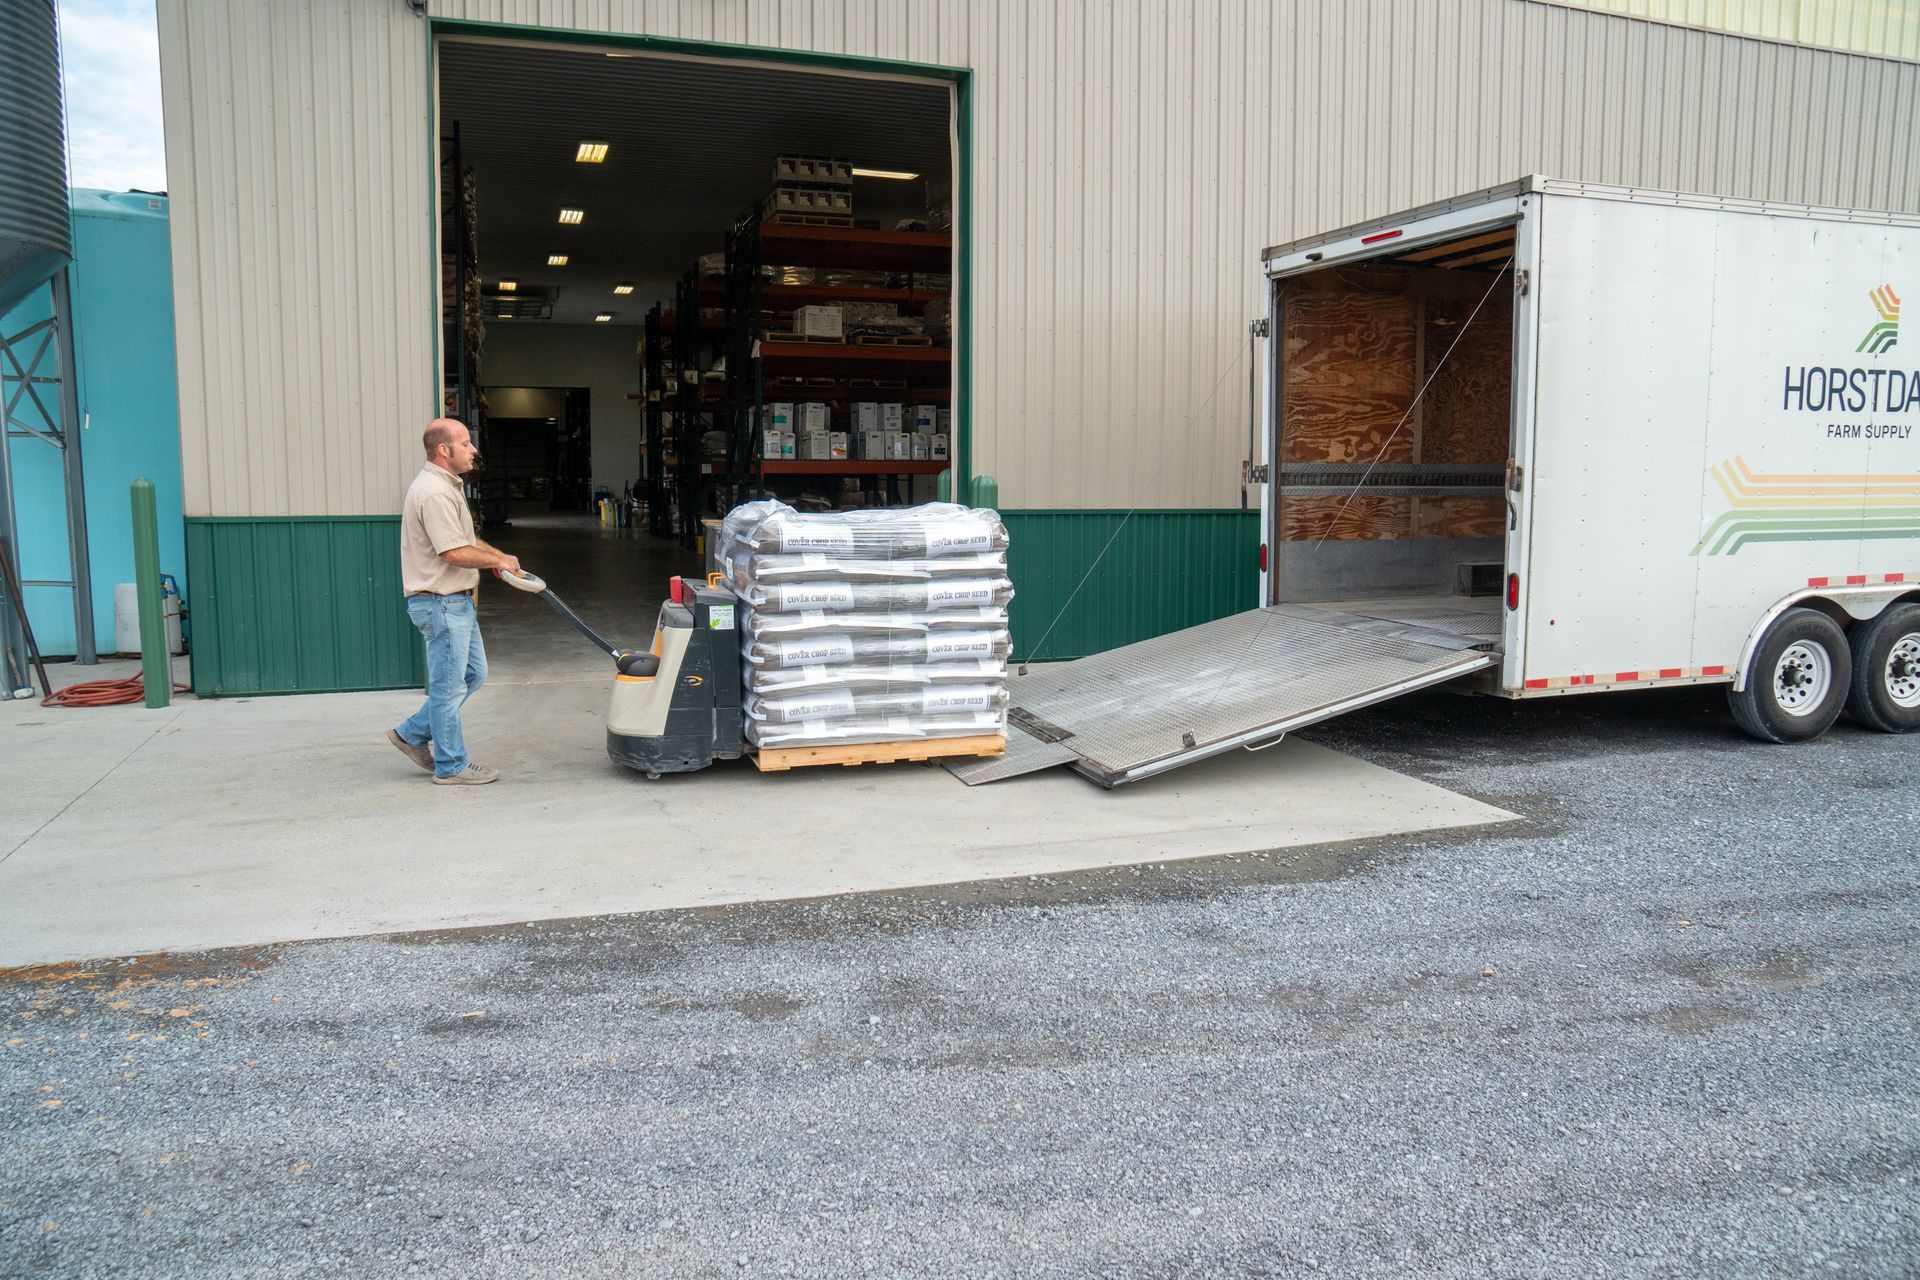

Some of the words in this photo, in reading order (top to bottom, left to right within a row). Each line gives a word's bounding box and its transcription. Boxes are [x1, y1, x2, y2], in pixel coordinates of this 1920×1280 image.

[1784, 366, 1920, 412] HORSTDA
[1827, 424, 1861, 438] FARM
[1865, 424, 1912, 439] SUPPLY
[931, 537, 952, 548] COVER
[970, 536, 987, 544] SEED
[787, 594, 810, 604] COVER
[932, 591, 953, 601] COVER
[954, 591, 970, 599] CROP
[971, 590, 988, 598] SEED
[932, 644, 953, 653] COVER
[954, 644, 970, 652] CROP
[787, 650, 810, 660] COVER
[811, 650, 829, 658] CROP
[928, 698, 949, 707] COVER
[950, 698, 966, 706] CROP
[967, 697, 984, 705] SEED
[789, 706, 811, 716] COVER
